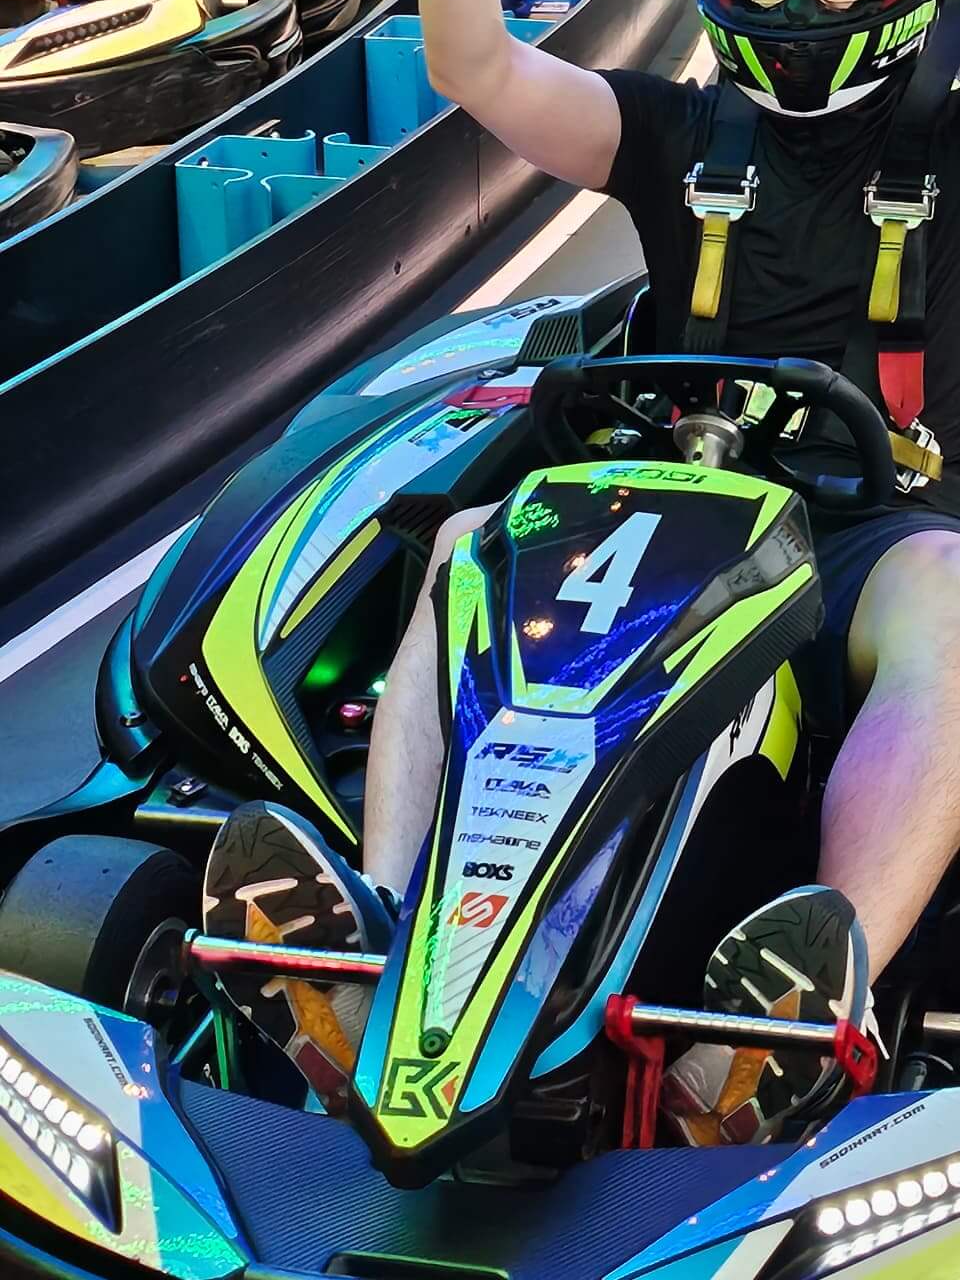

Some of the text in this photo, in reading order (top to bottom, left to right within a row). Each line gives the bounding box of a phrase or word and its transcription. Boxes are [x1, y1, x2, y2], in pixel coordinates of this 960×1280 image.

[555, 511, 664, 635] 4
[471, 805, 550, 825] TEKNEEX
[462, 861, 516, 881] BOXS
